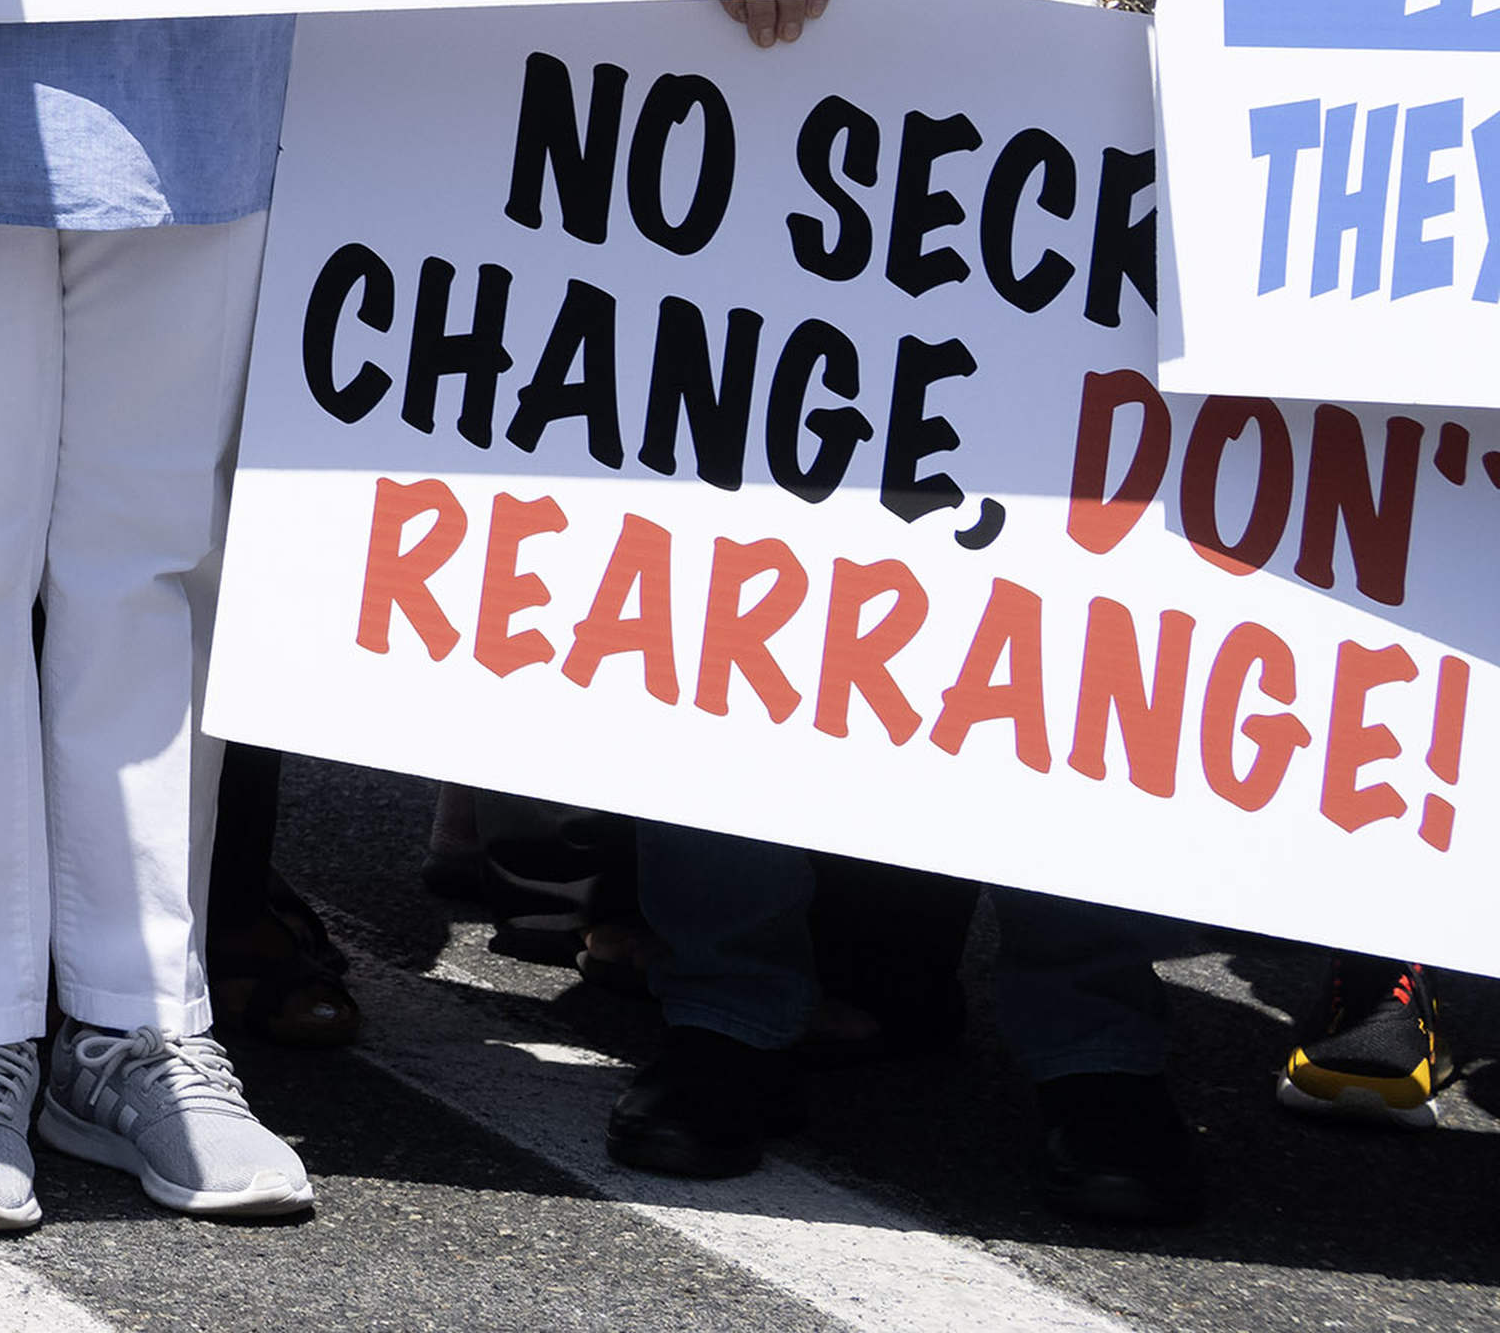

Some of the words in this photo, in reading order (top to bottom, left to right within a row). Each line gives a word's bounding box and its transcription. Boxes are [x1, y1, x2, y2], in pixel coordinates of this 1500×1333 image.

[504, 51, 736, 256] NO
[303, 242, 1006, 551] CHANGE,
[1066, 369, 1500, 607] DON'
[357, 478, 1469, 851] REARRANGE!
